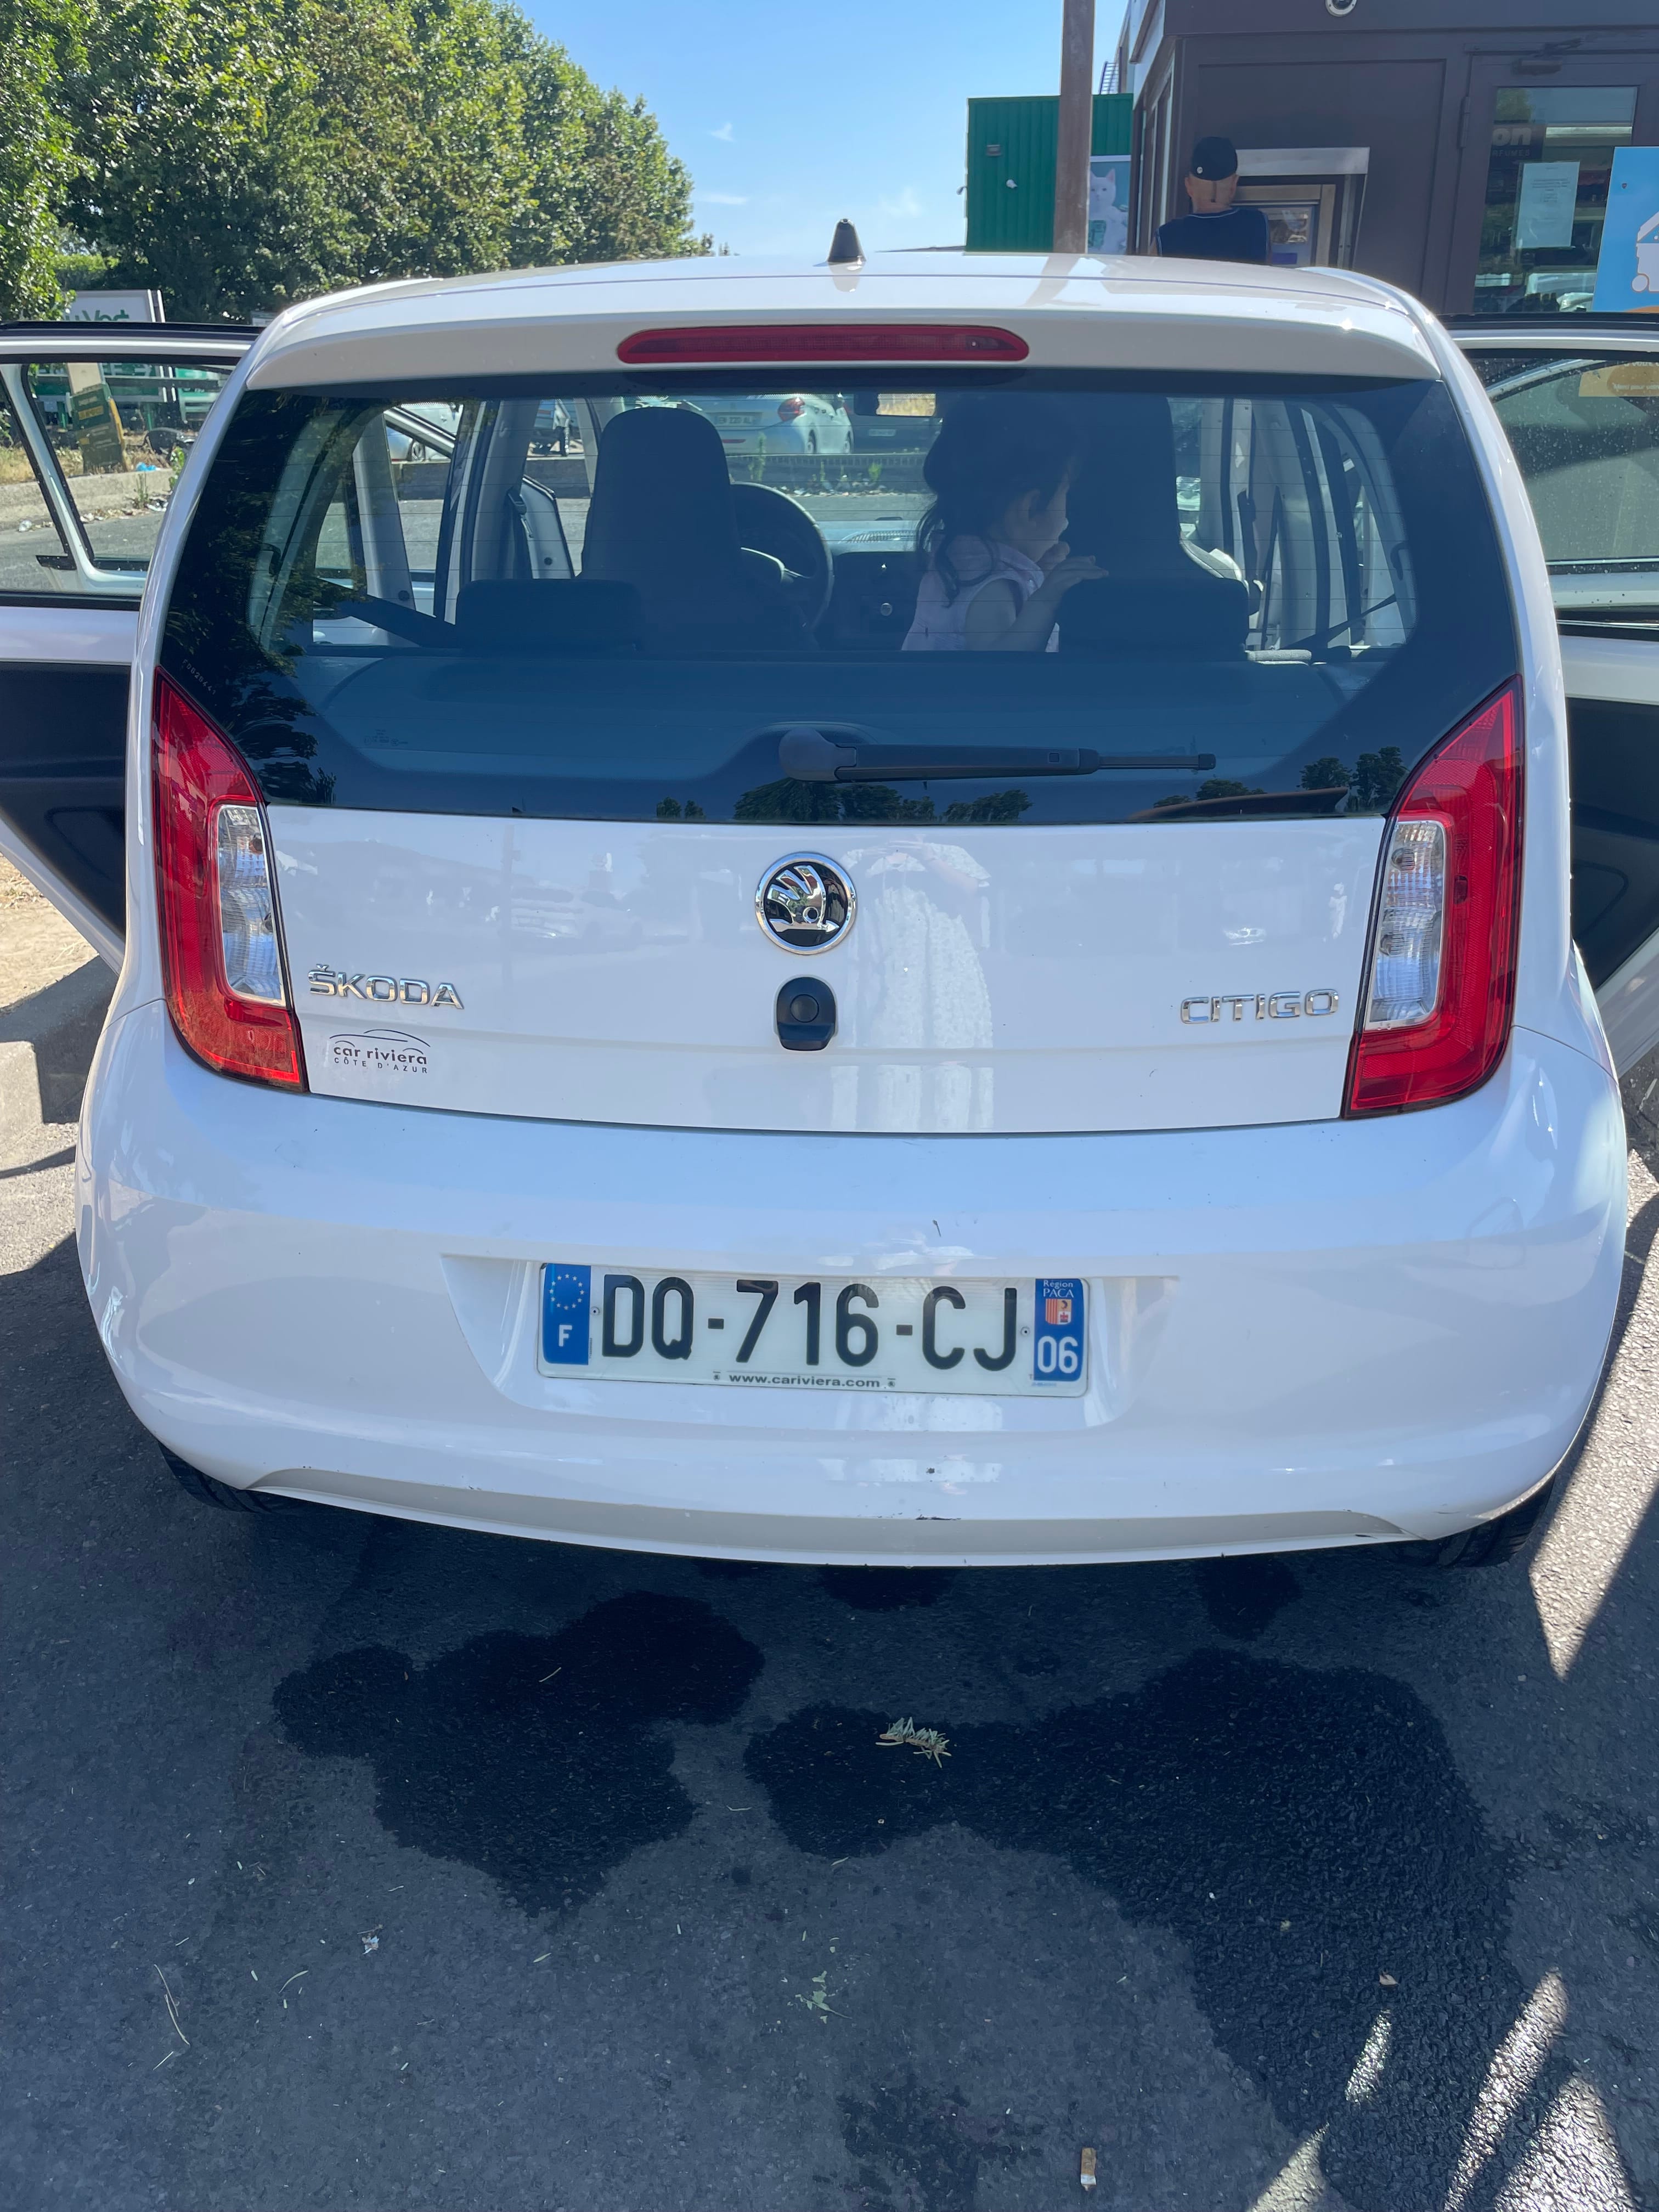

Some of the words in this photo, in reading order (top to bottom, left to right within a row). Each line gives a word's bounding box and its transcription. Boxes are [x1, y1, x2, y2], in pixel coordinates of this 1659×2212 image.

[308, 964, 465, 1009] ŠKODA
[1180, 988, 1340, 1024] CITIGO
[334, 1046, 361, 1057] car
[367, 1047, 427, 1064] riviera
[334, 1057, 367, 1068] CÔTE
[377, 1062, 428, 1074] D'AZUR
[1043, 1279, 1074, 1289] Région
[1043, 1288, 1074, 1298] PACA
[602, 1274, 1017, 1372] DQ-716-CJ
[558, 1324, 573, 1347] F
[1037, 1335, 1078, 1374] 06
[729, 1373, 881, 1387] www.cariviera.com
